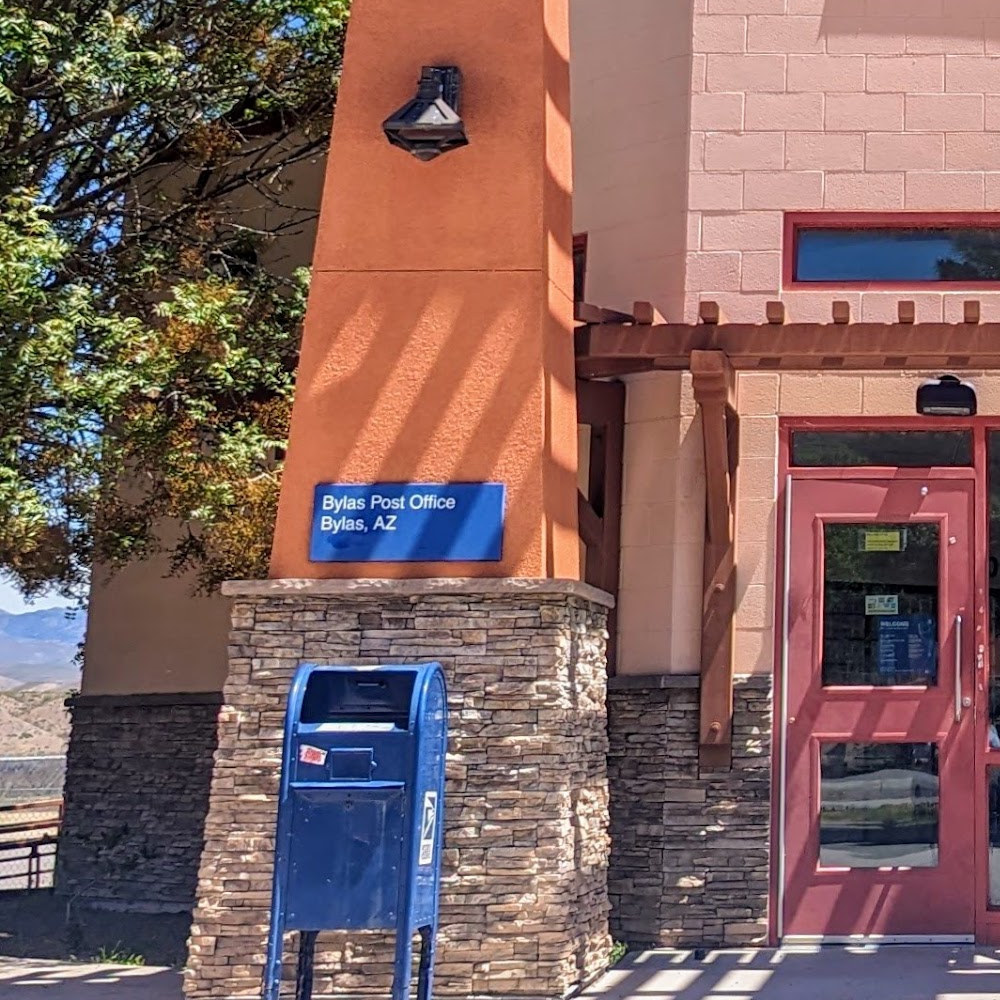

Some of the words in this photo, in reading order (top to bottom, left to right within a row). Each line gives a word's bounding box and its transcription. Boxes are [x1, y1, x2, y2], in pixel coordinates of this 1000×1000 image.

[323, 495, 365, 513] Bylas
[371, 495, 405, 510] Post
[409, 495, 456, 509] Office
[321, 516, 368, 534] Bylas,
[373, 516, 397, 531] AZ
